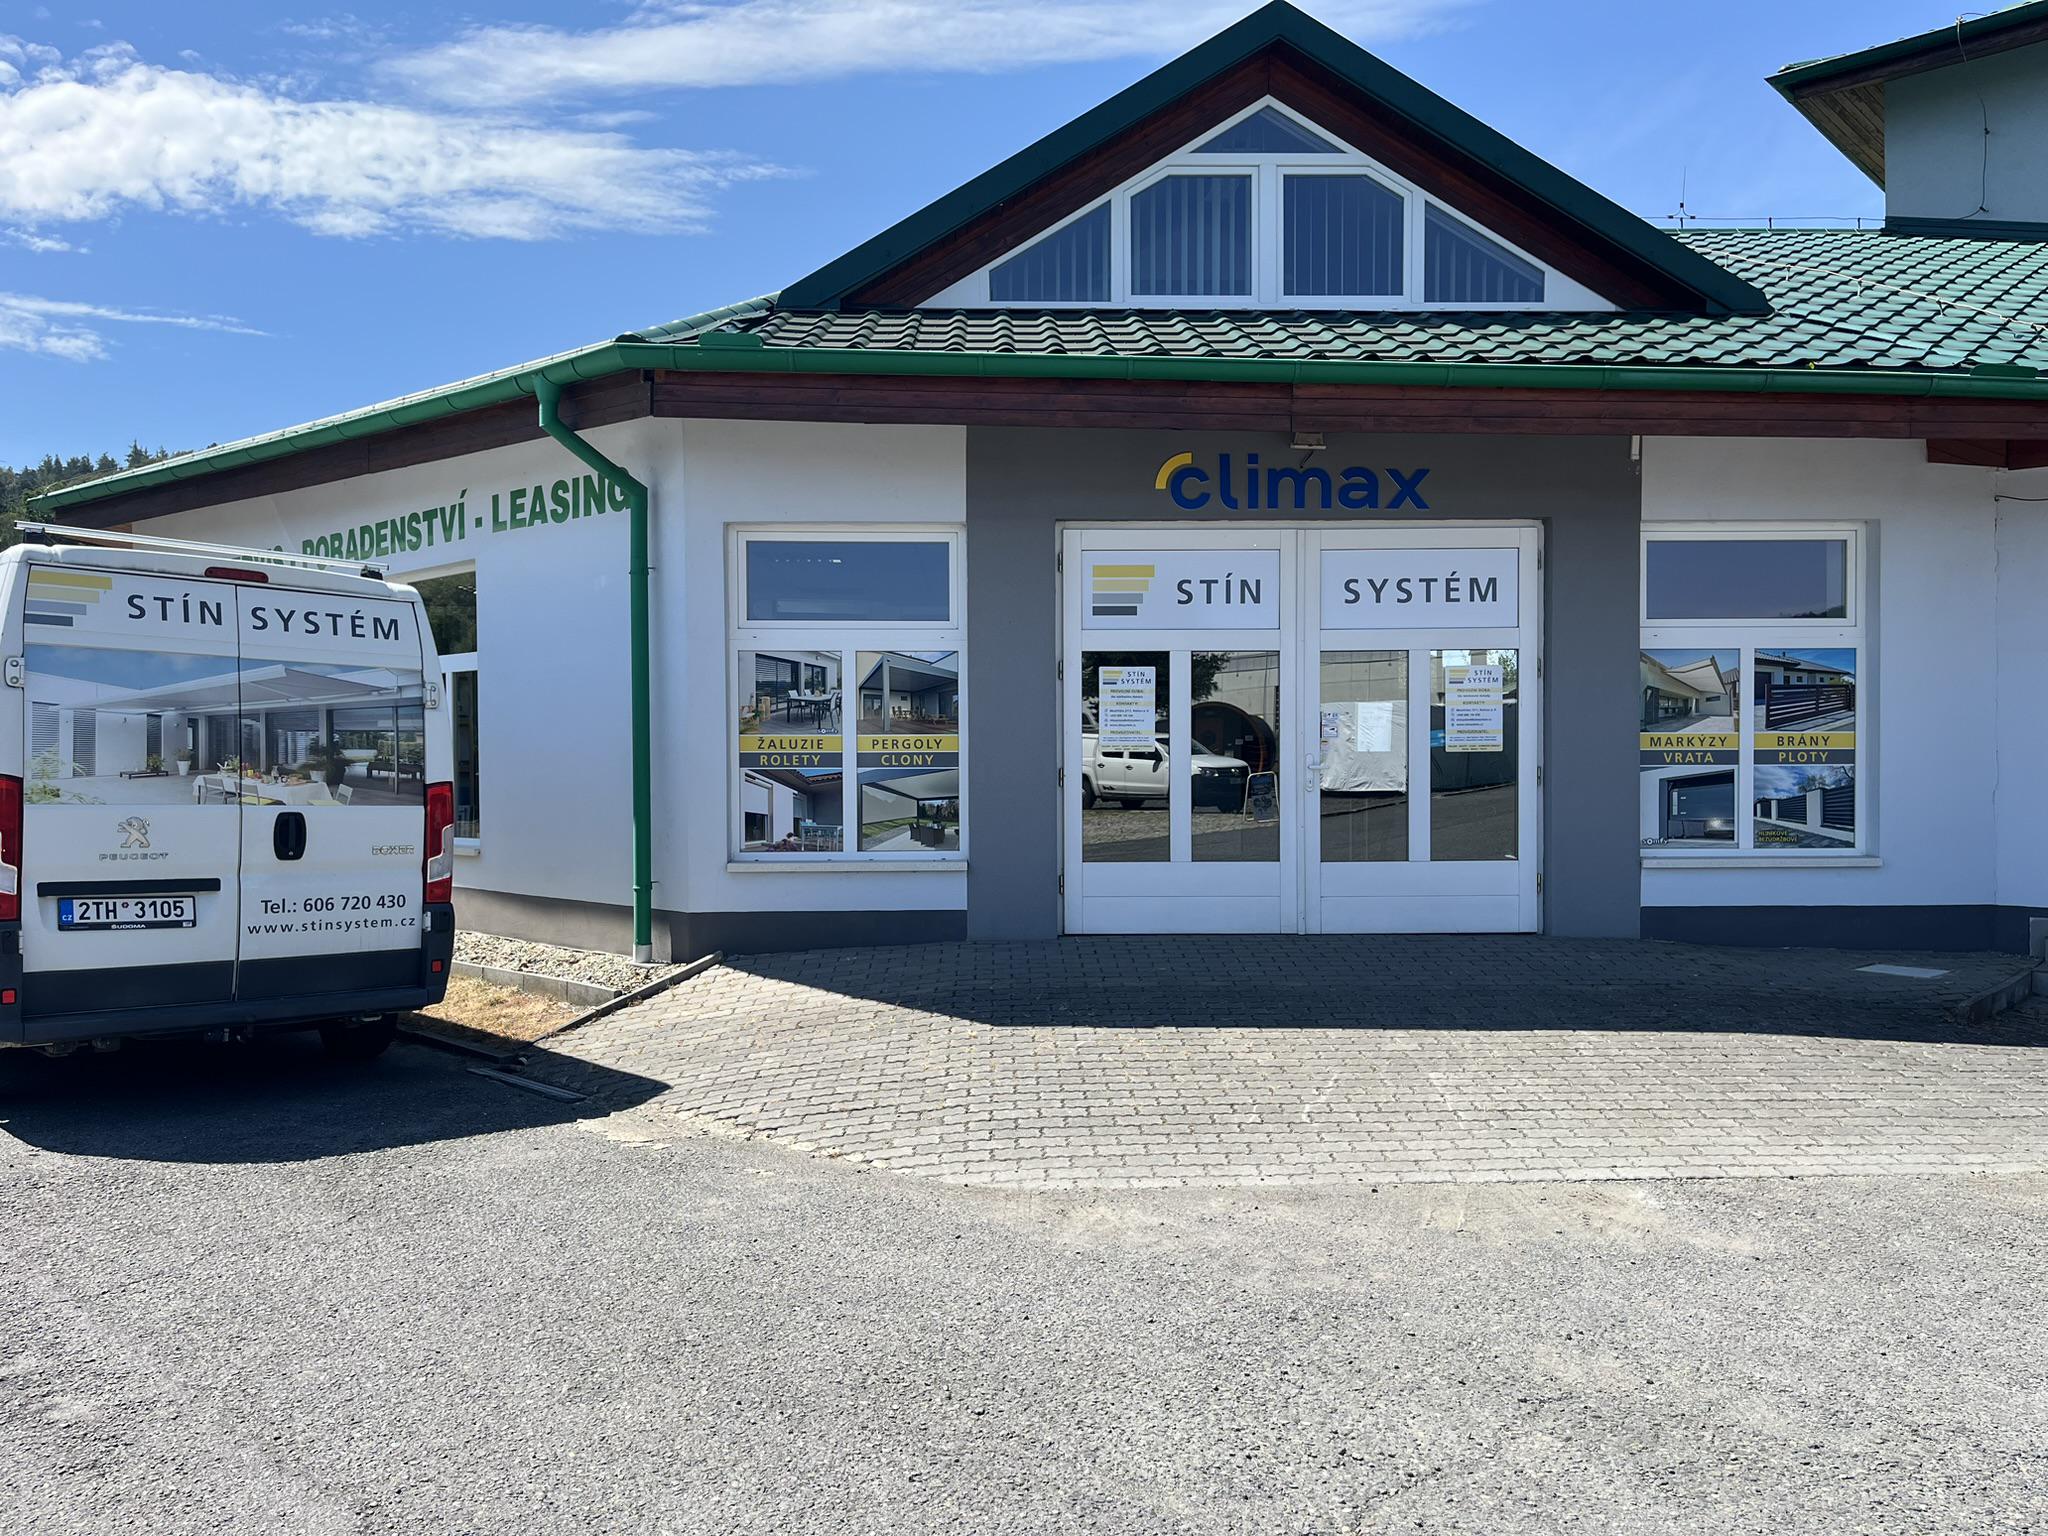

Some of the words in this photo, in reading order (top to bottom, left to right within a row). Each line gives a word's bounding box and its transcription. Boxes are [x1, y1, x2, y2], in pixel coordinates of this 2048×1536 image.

[1170, 453, 1431, 510] climax
[1176, 572, 1262, 605] STÍN
[1343, 571, 1498, 604] SYSTÉM
[127, 593, 223, 626] STÍN
[251, 606, 400, 641] SYSTÉM
[757, 737, 824, 750] ŽALUZIE
[872, 739, 943, 750] PERGOLY
[1650, 734, 1728, 747] MARKÝZY
[1777, 733, 1831, 746] BRÁNY
[759, 754, 822, 766] ROLETY
[880, 754, 935, 766] CLONY
[1663, 752, 1714, 763] VRATA
[1778, 751, 1829, 763] PLOTY
[98, 852, 169, 861] PEUGEOT
[78, 901, 118, 921] 2TH
[135, 900, 185, 919] 3105
[261, 898, 297, 914] Tel.:
[303, 897, 334, 912] 606
[341, 896, 371, 911] 720
[376, 894, 407, 909] 430
[248, 917, 416, 934] www.stinsystem.cz
